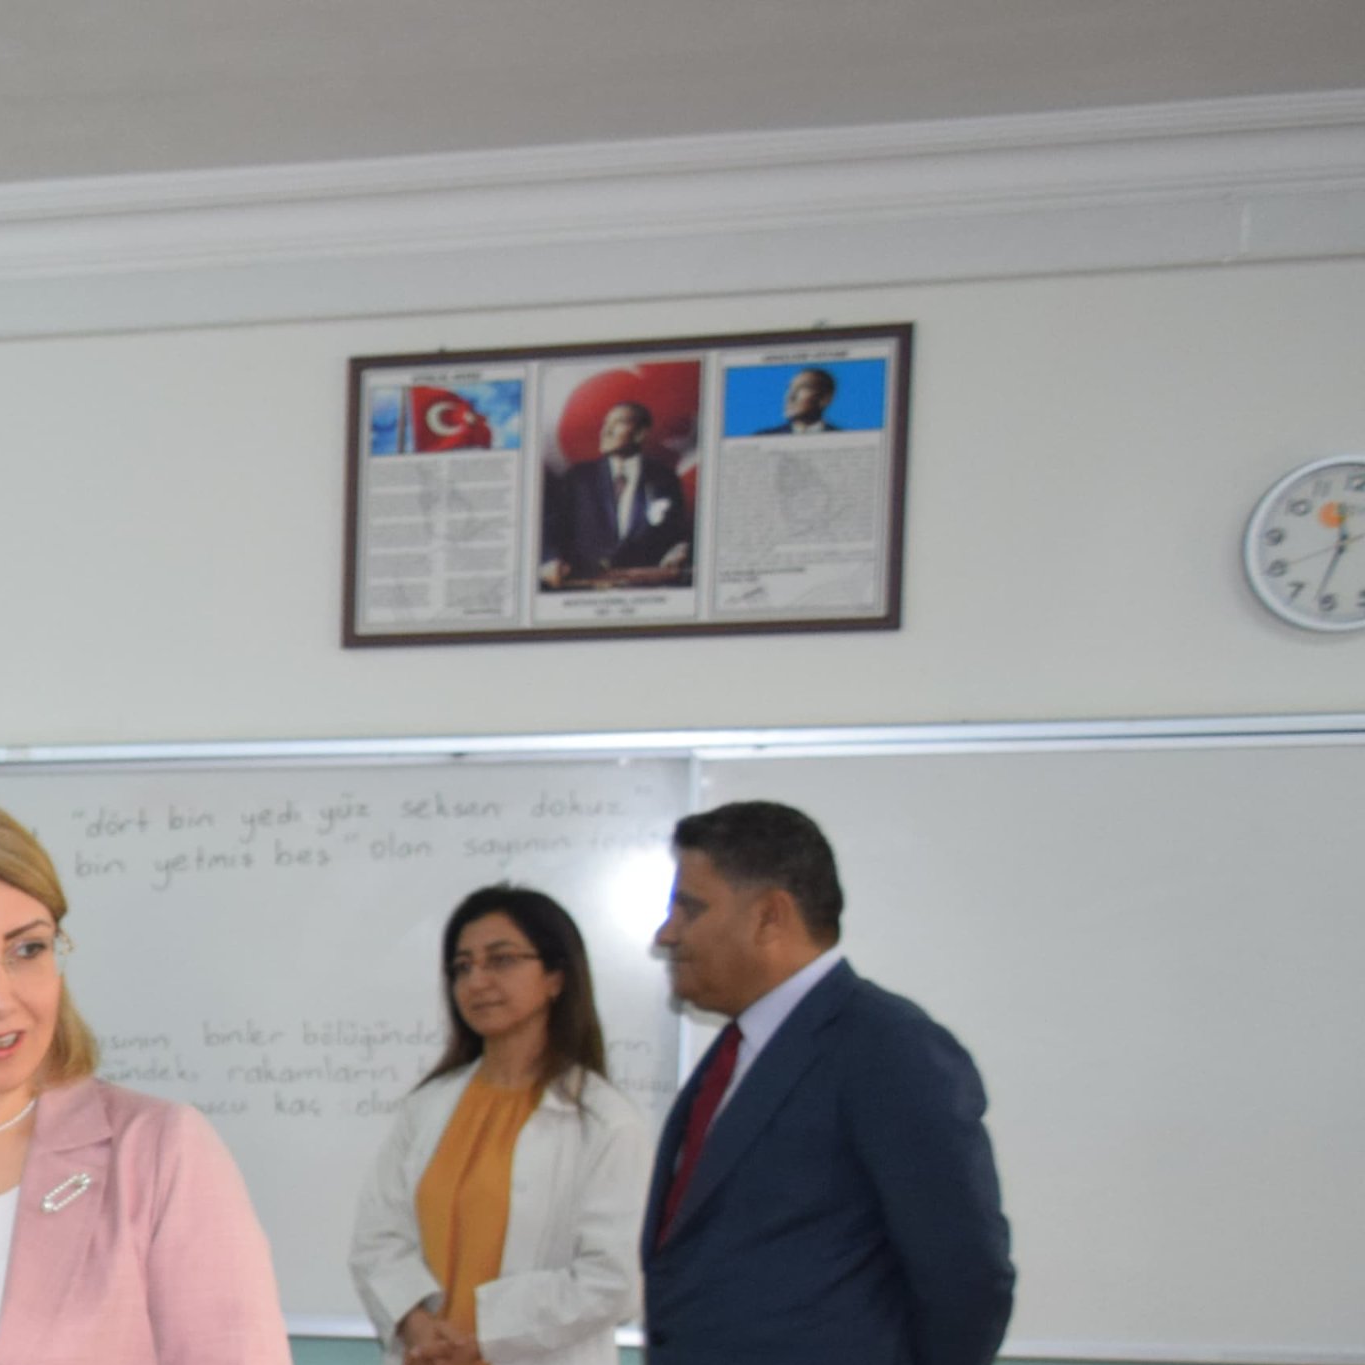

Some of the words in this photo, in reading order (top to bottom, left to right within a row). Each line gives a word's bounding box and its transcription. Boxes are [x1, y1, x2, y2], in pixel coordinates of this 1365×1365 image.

[1289, 581, 1307, 603] 7
[169, 803, 215, 831] bin
[316, 790, 370, 836] yüz
[400, 790, 503, 820] seksen
[74, 850, 127, 878] bin
[369, 830, 433, 861] olan
[201, 1018, 285, 1047] binler
